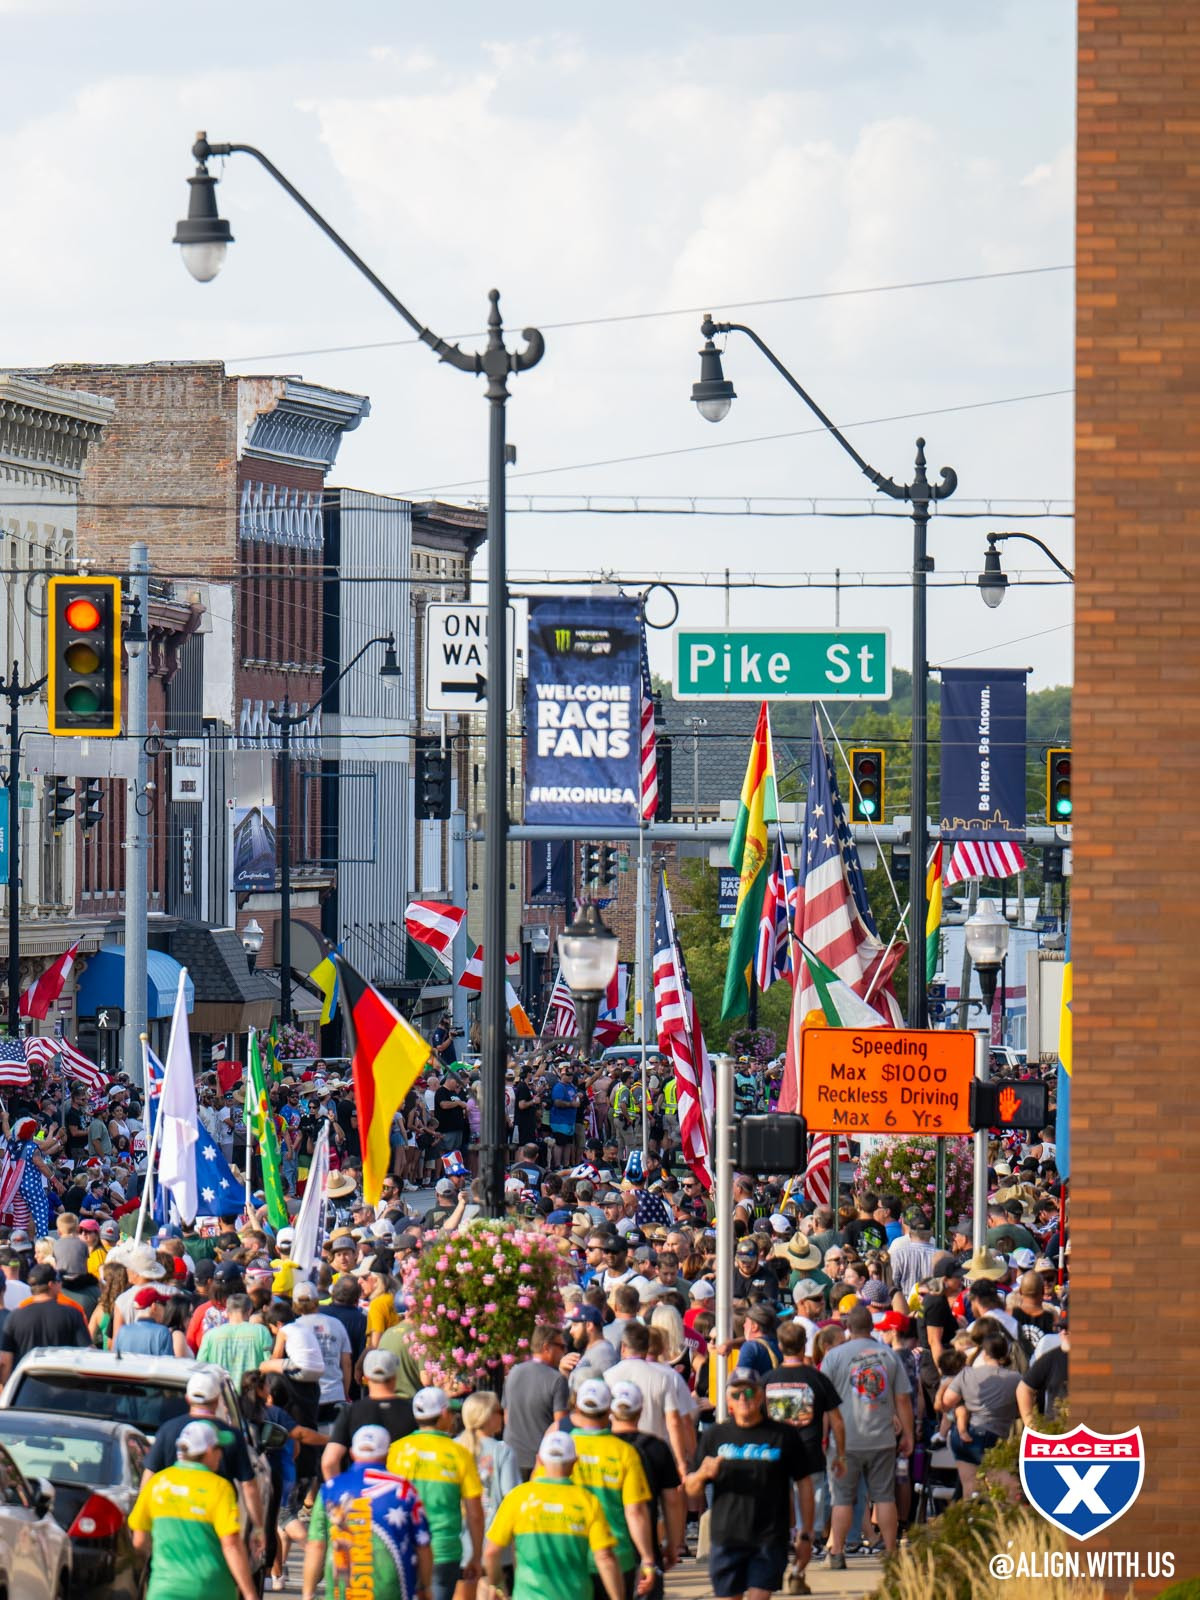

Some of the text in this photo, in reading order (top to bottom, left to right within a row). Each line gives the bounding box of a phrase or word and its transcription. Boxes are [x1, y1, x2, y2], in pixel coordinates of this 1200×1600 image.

[444, 614, 489, 637] ON
[442, 643, 489, 666] WA
[689, 643, 875, 684] Pike St
[536, 684, 631, 701] WELCOME
[537, 700, 631, 730] RACE
[537, 728, 631, 759] FANS
[978, 684, 991, 812] Be Here. Be Known.
[529, 786, 636, 804] #MXONUSA
[721, 881, 741, 889] RAC
[721, 889, 739, 897] FAN
[851, 1036, 928, 1061] Speeding
[830, 1063, 867, 1081] Max
[817, 1085, 960, 1111] Reckless Driving
[833, 1108, 943, 1128] Max 6 Yrs
[345, 1496, 374, 1600] USTRALIA
